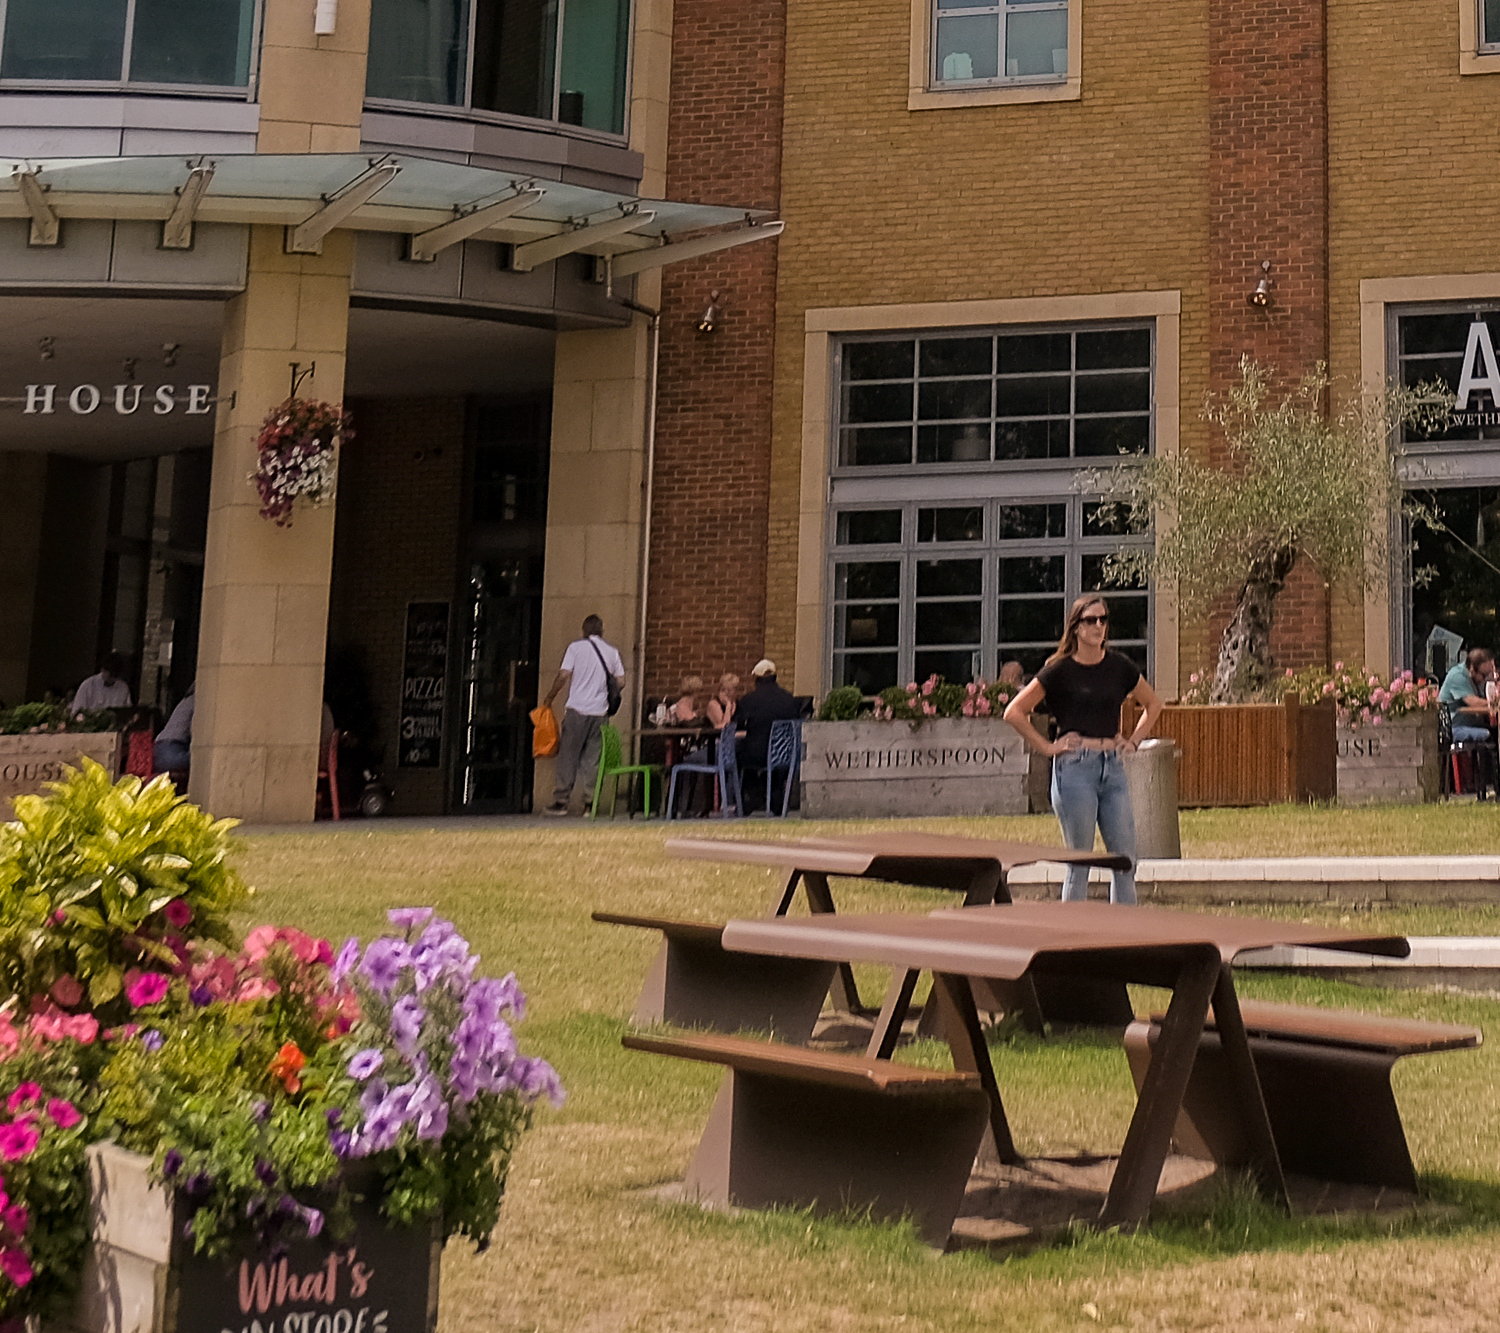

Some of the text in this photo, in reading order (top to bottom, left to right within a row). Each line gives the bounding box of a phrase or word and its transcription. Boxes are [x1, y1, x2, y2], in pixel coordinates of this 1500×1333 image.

[22, 384, 211, 415] HOUSE
[405, 677, 444, 699] PIZZA
[825, 746, 1007, 769] WETHERSPOON
[1337, 739, 1381, 758] USE
[238, 1247, 375, 1315] What's
